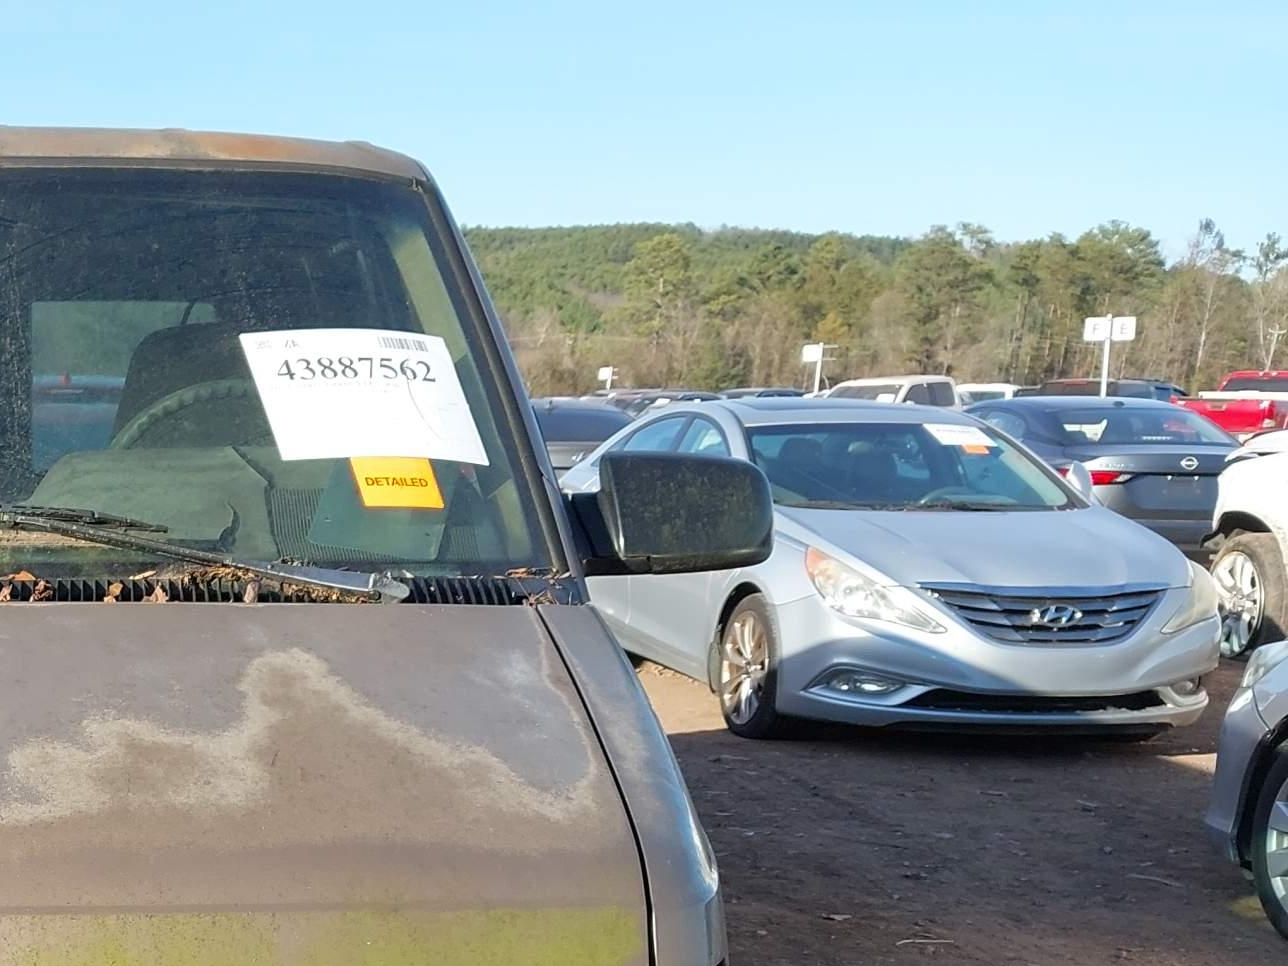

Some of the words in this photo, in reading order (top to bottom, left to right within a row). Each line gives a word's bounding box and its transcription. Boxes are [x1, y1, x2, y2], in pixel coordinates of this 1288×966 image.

[1120, 323, 1129, 335] E
[277, 356, 436, 383] 43887562
[364, 476, 429, 488] DETAILED
